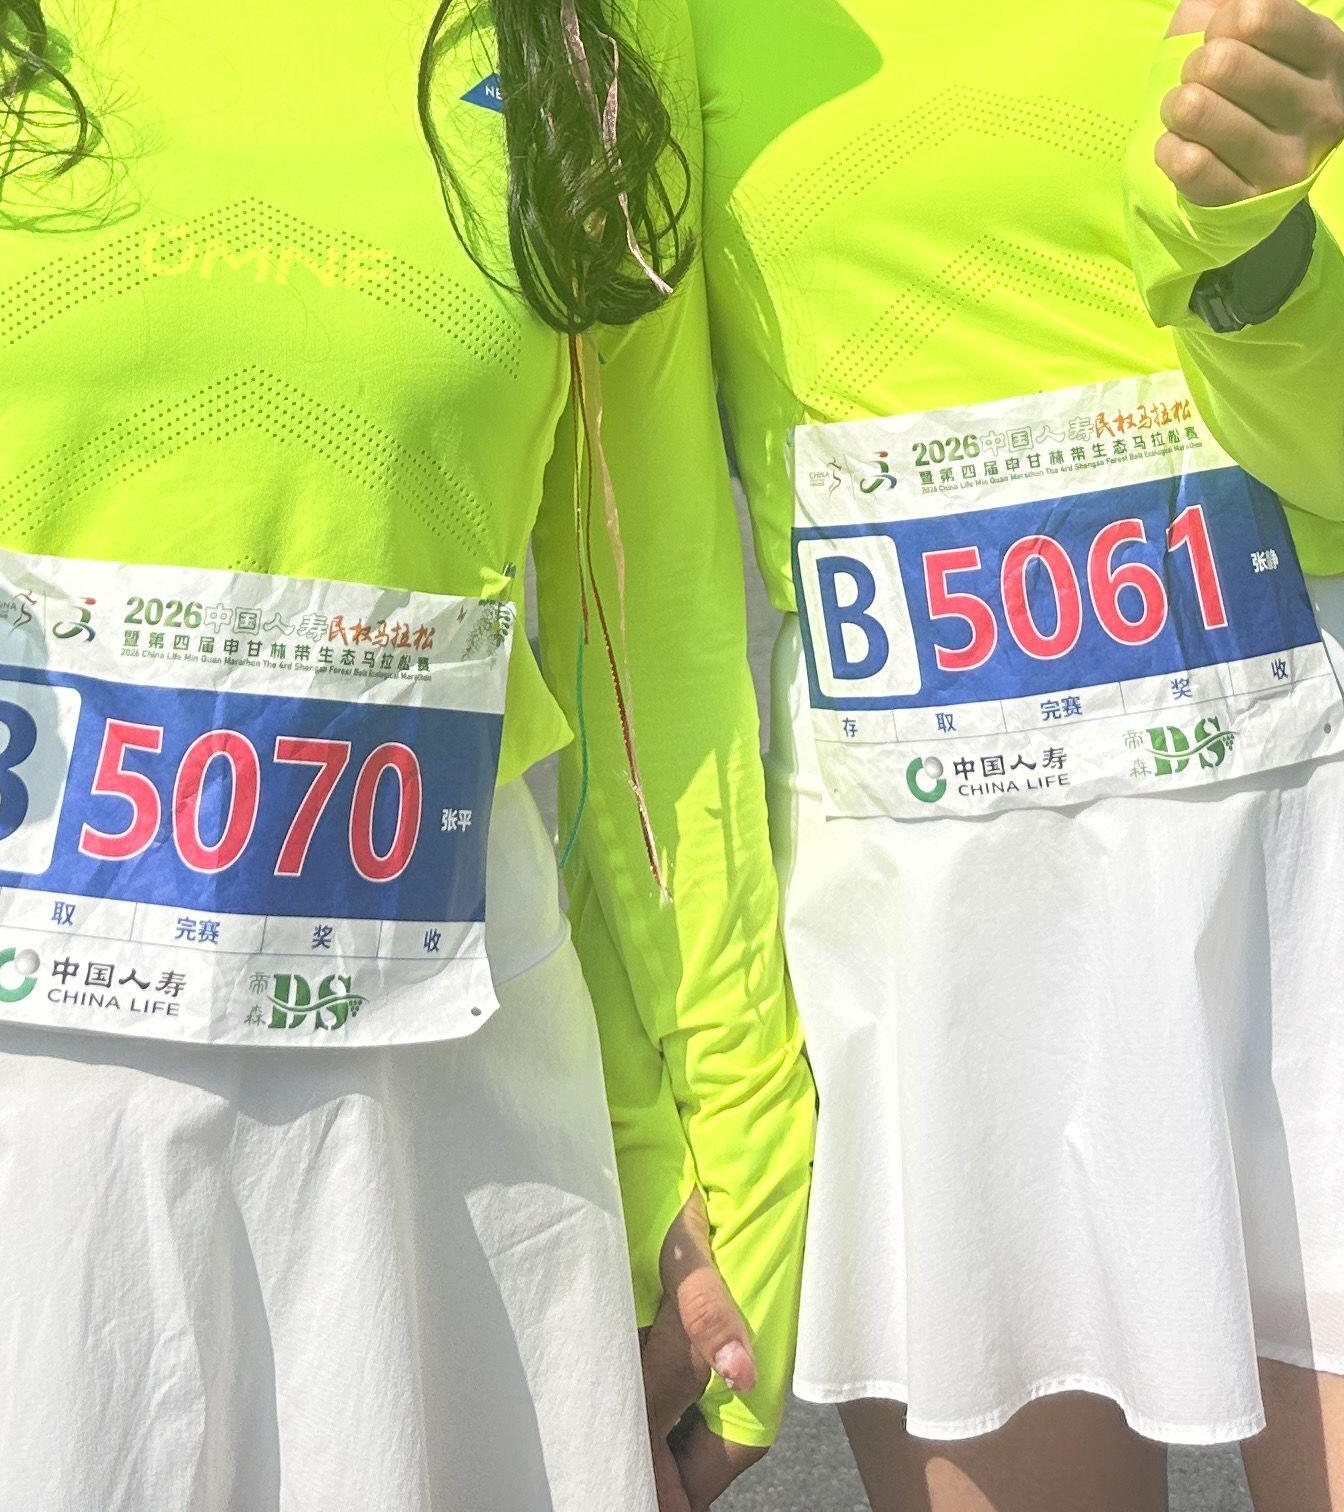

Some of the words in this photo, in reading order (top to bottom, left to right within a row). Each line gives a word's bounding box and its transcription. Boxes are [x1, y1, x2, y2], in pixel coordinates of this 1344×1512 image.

[816, 554, 891, 681] B
[921, 504, 1229, 671] 5061
[842, 717, 858, 738] 存
[935, 712, 956, 733] 取
[1040, 695, 1083, 722] 完赛
[1170, 676, 1193, 700] 奖
[1271, 657, 1289, 680] 收
[952, 746, 1068, 780] 中国人寿
[1145, 716, 1227, 777] DS
[78, 717, 423, 882] 5070
[958, 779, 1021, 798] CHINA
[1026, 772, 1072, 790] LIFE
[440, 807, 472, 832] 张平
[51, 900, 76, 926] 取
[174, 916, 221, 945] 完赛
[311, 923, 337, 950] 奖
[423, 928, 442, 953] 收
[47, 987, 122, 1010] CHINA
[130, 997, 181, 1018] LIFE
[51, 956, 187, 998] 中国人寿
[267, 972, 353, 1031] DS
